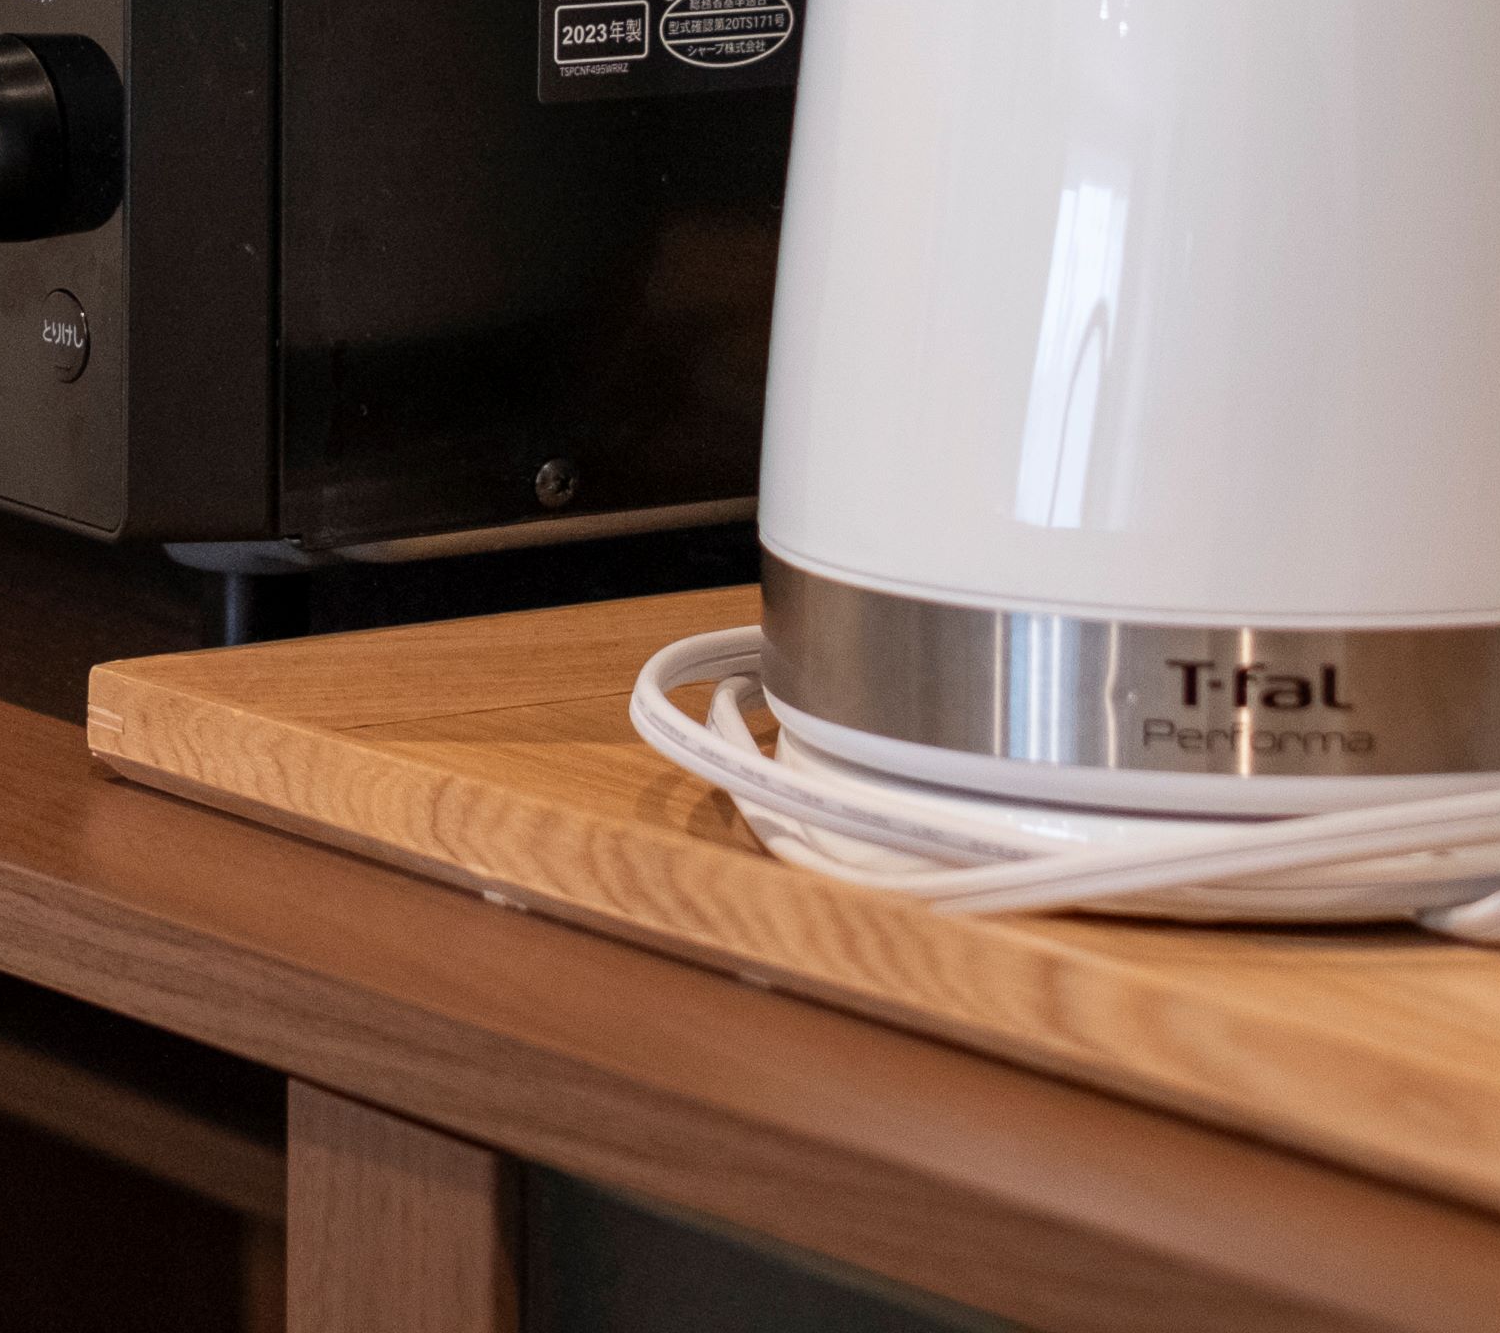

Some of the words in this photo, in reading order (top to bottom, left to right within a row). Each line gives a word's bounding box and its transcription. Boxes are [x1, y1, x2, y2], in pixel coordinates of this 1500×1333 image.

[562, 19, 641, 45] 2023年製
[668, 13, 785, 36] 型式確認第20TS171号
[687, 40, 766, 58] シャープ株式会社
[42, 318, 84, 348] とりけし
[1141, 717, 1377, 755] Performa
